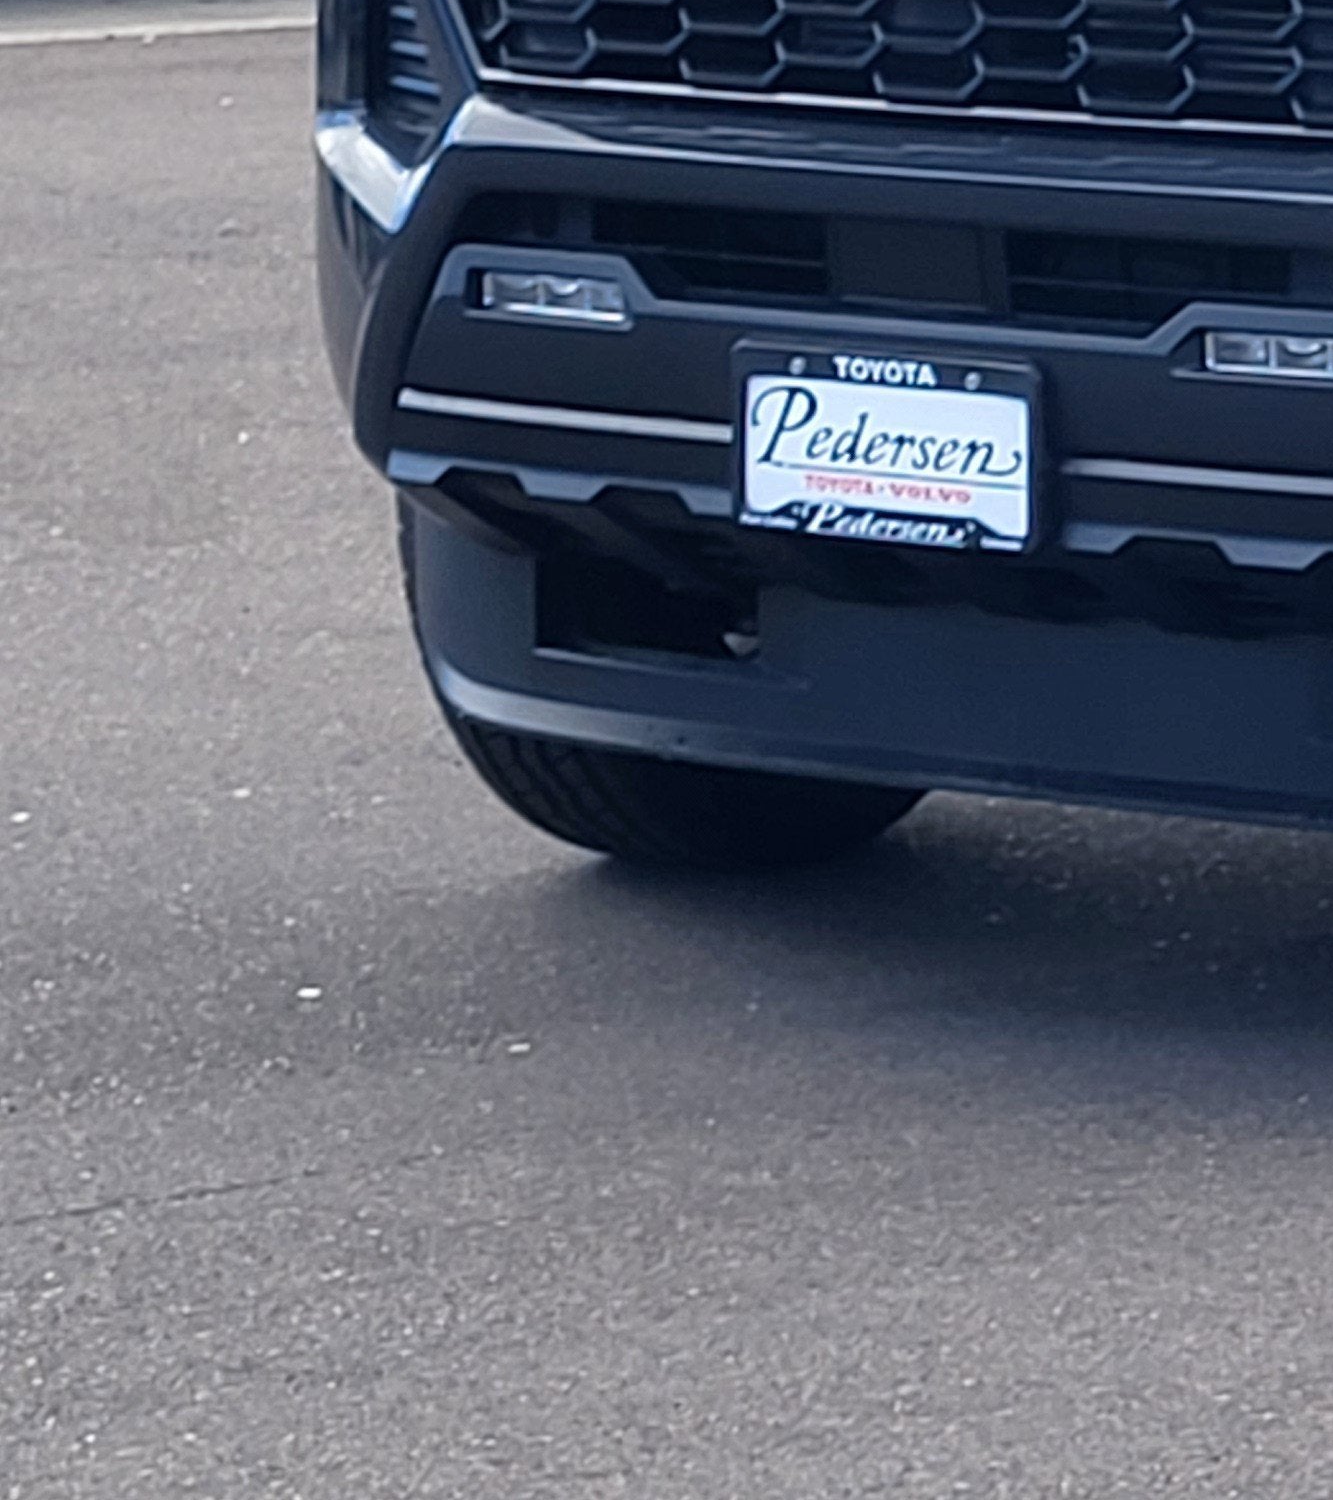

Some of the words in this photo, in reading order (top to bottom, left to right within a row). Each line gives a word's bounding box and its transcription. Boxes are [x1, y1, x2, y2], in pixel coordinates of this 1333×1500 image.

[832, 356, 938, 387] TOYOTA
[752, 385, 1023, 476] Pedersen
[796, 503, 970, 549] Pedersen
